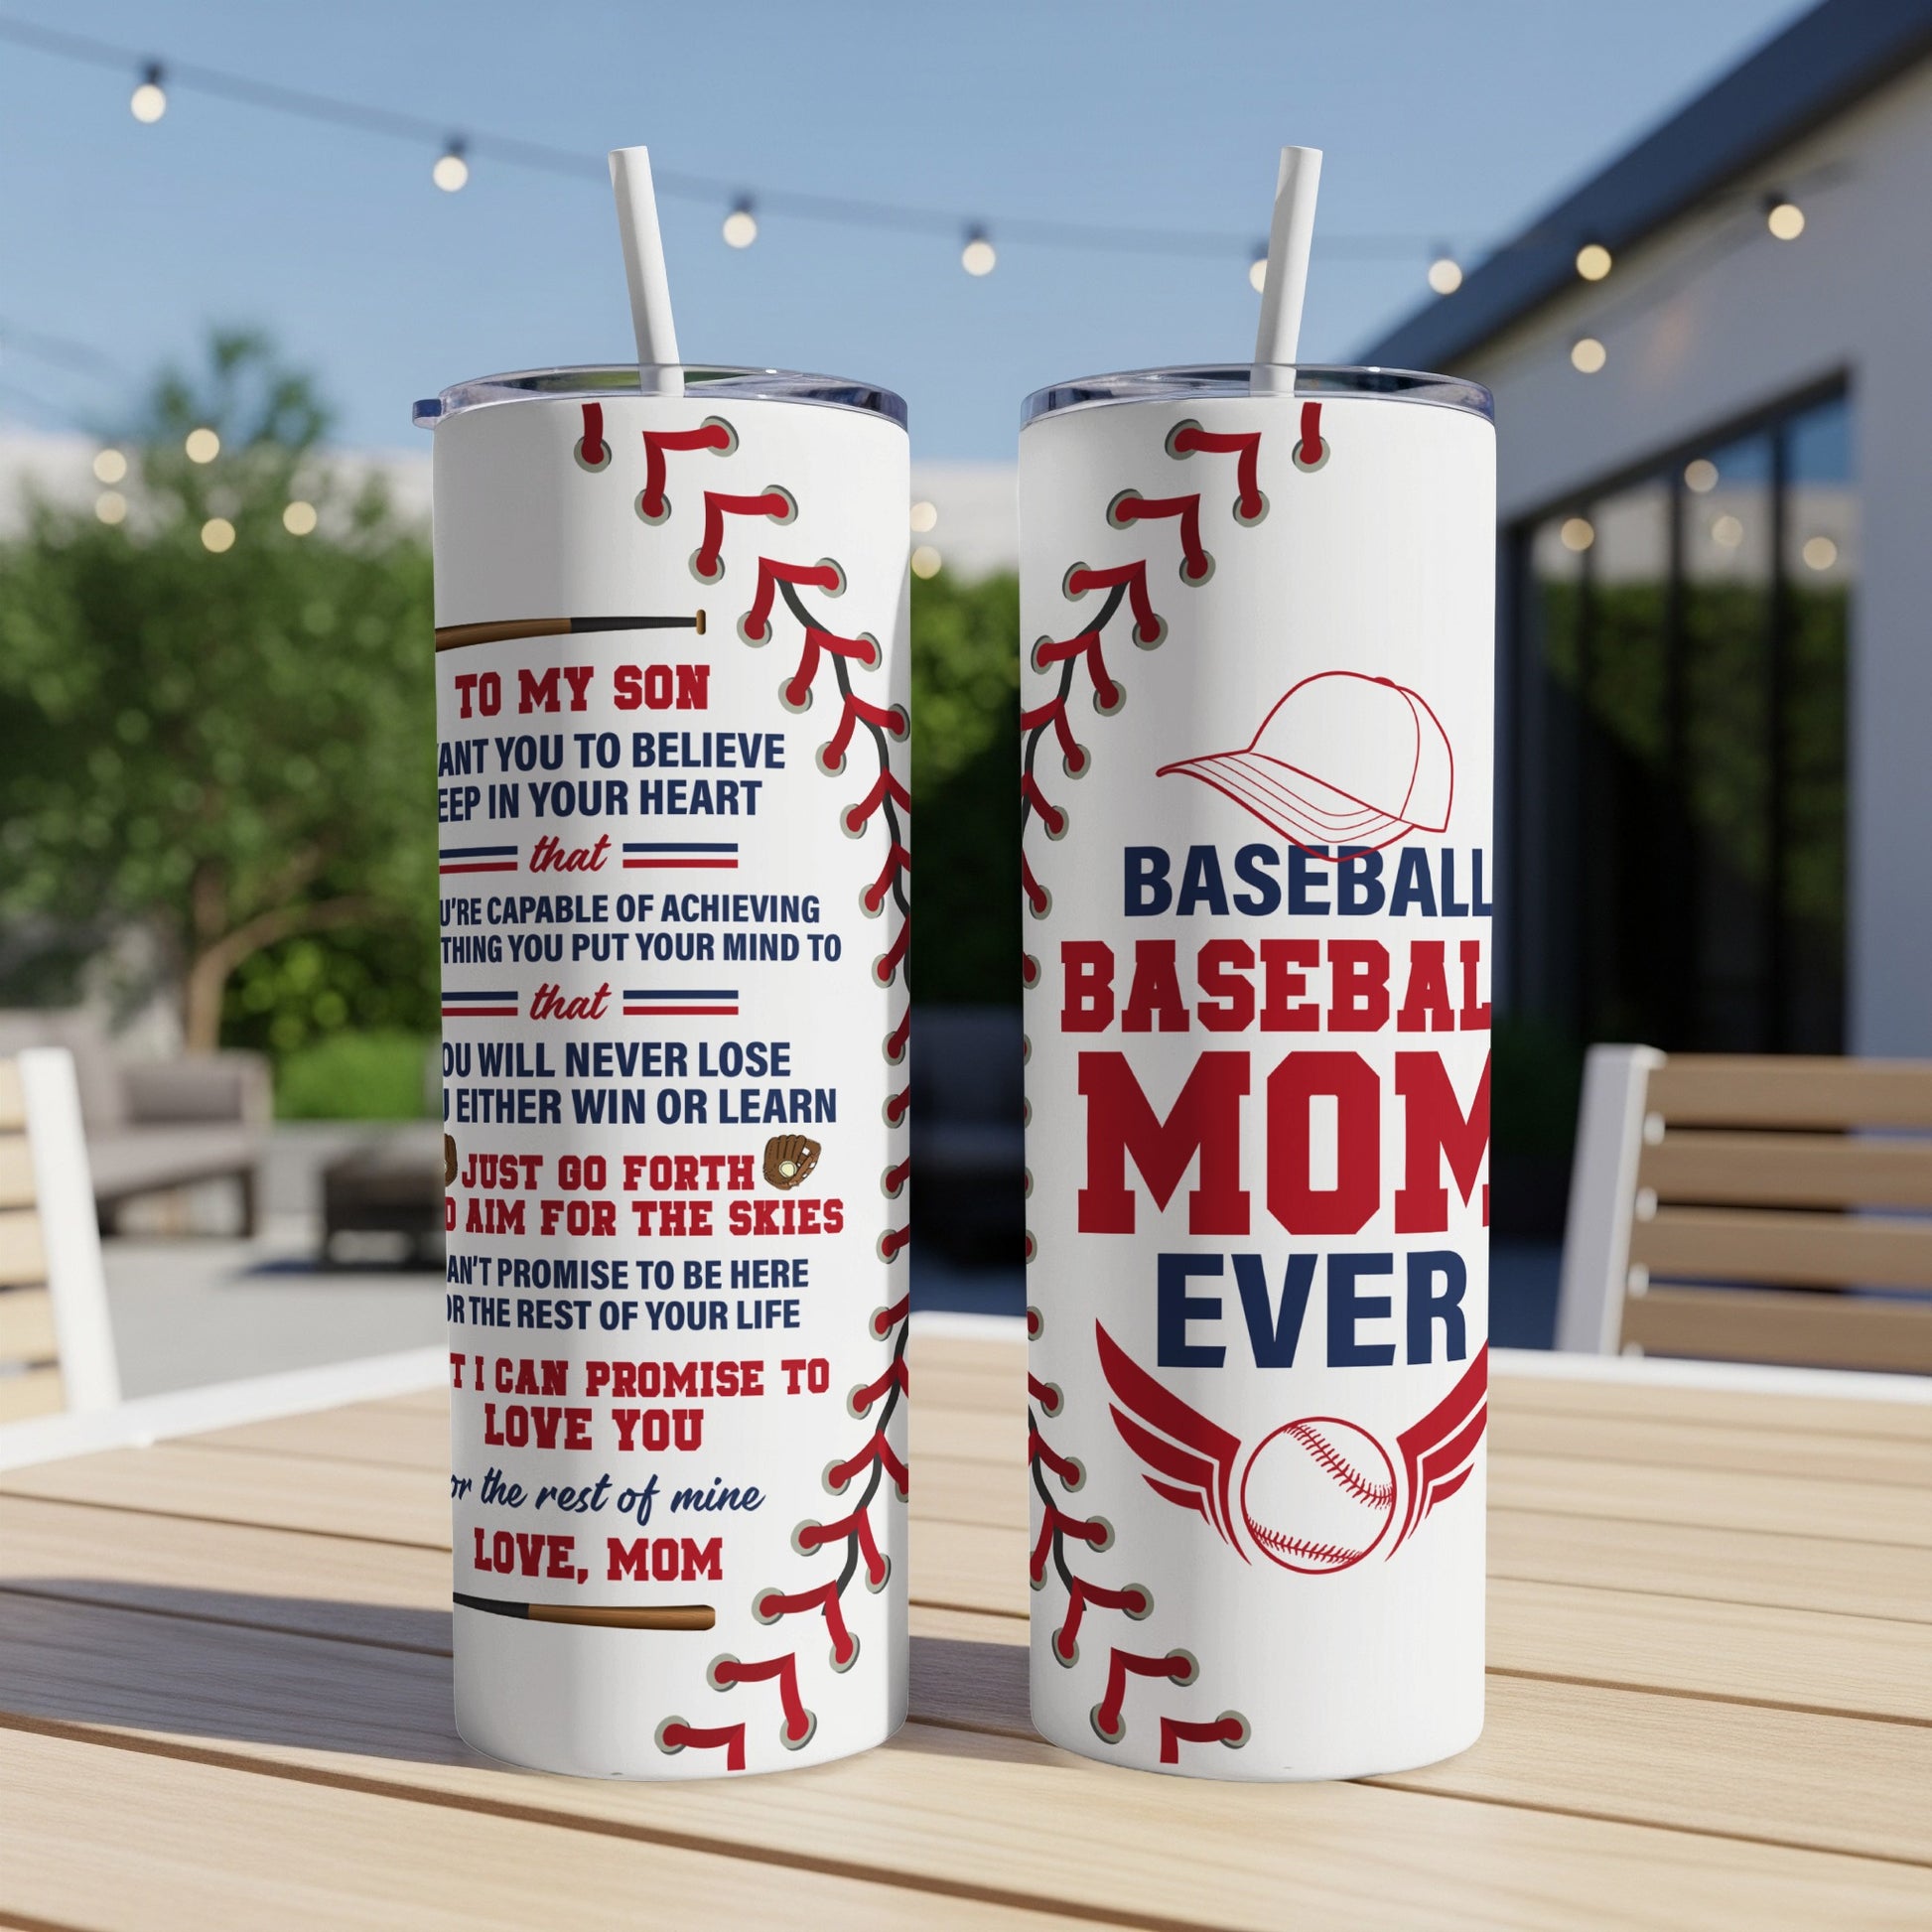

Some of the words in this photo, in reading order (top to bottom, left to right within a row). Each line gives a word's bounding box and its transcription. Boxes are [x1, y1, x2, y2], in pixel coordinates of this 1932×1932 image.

[455, 672, 500, 719] TO
[518, 666, 594, 714] MY
[614, 665, 710, 711] SON
[437, 739, 488, 776] ANT
[495, 735, 563, 772] YOU
[574, 733, 621, 769] TO
[632, 733, 785, 768] BELIEVE
[488, 783, 519, 819] IN
[528, 780, 628, 817] YOUR
[639, 780, 762, 815] HEART
[529, 833, 612, 873] that
[1124, 844, 1493, 917] BASEBALL
[487, 895, 609, 924] CAPABLE
[617, 894, 653, 922] OF
[661, 895, 820, 923] ACHIEVING
[508, 934, 563, 962] YOU
[572, 932, 629, 961] PUT
[635, 932, 715, 961] YOUR
[724, 933, 799, 961] MIND
[807, 934, 842, 961] TO
[529, 982, 612, 1021] that
[479, 1042, 555, 1077] WILL
[566, 1041, 687, 1077] NEVER
[698, 1041, 790, 1077] LOSE
[457, 1088, 562, 1124] EITHER
[573, 1089, 645, 1124] WIN
[656, 1088, 707, 1124] OR
[719, 1088, 837, 1124] LEARN
[1078, 1048, 1490, 1235] MOM
[462, 1154, 543, 1190] JUST
[558, 1155, 607, 1190] GO
[622, 1155, 755, 1190] FORTH
[466, 1197, 525, 1235] AIM
[540, 1200, 616, 1236] FOR
[632, 1201, 713, 1236] THE
[729, 1198, 844, 1235] SKIES
[497, 1258, 628, 1290] PROMISE
[636, 1260, 674, 1290] TO
[683, 1260, 722, 1289] BE
[731, 1258, 808, 1289] HERE
[469, 1296, 510, 1327] THE
[517, 1299, 591, 1330] REST
[600, 1301, 638, 1330] OF
[645, 1301, 729, 1330] YOUR
[737, 1299, 800, 1328] LIFE
[1157, 1250, 1468, 1369] EVER
[476, 1356, 484, 1392] I
[495, 1358, 568, 1396] CAN
[586, 1360, 764, 1398] PROMISE
[780, 1358, 829, 1395] TO
[484, 1403, 593, 1450] LOVE
[612, 1409, 704, 1451] YOU
[481, 1467, 525, 1508] the
[534, 1473, 612, 1514] rest
[618, 1474, 660, 1526] of
[670, 1477, 766, 1512] mine
[474, 1527, 589, 1585] LOVE,
[607, 1537, 723, 1582] MOM
